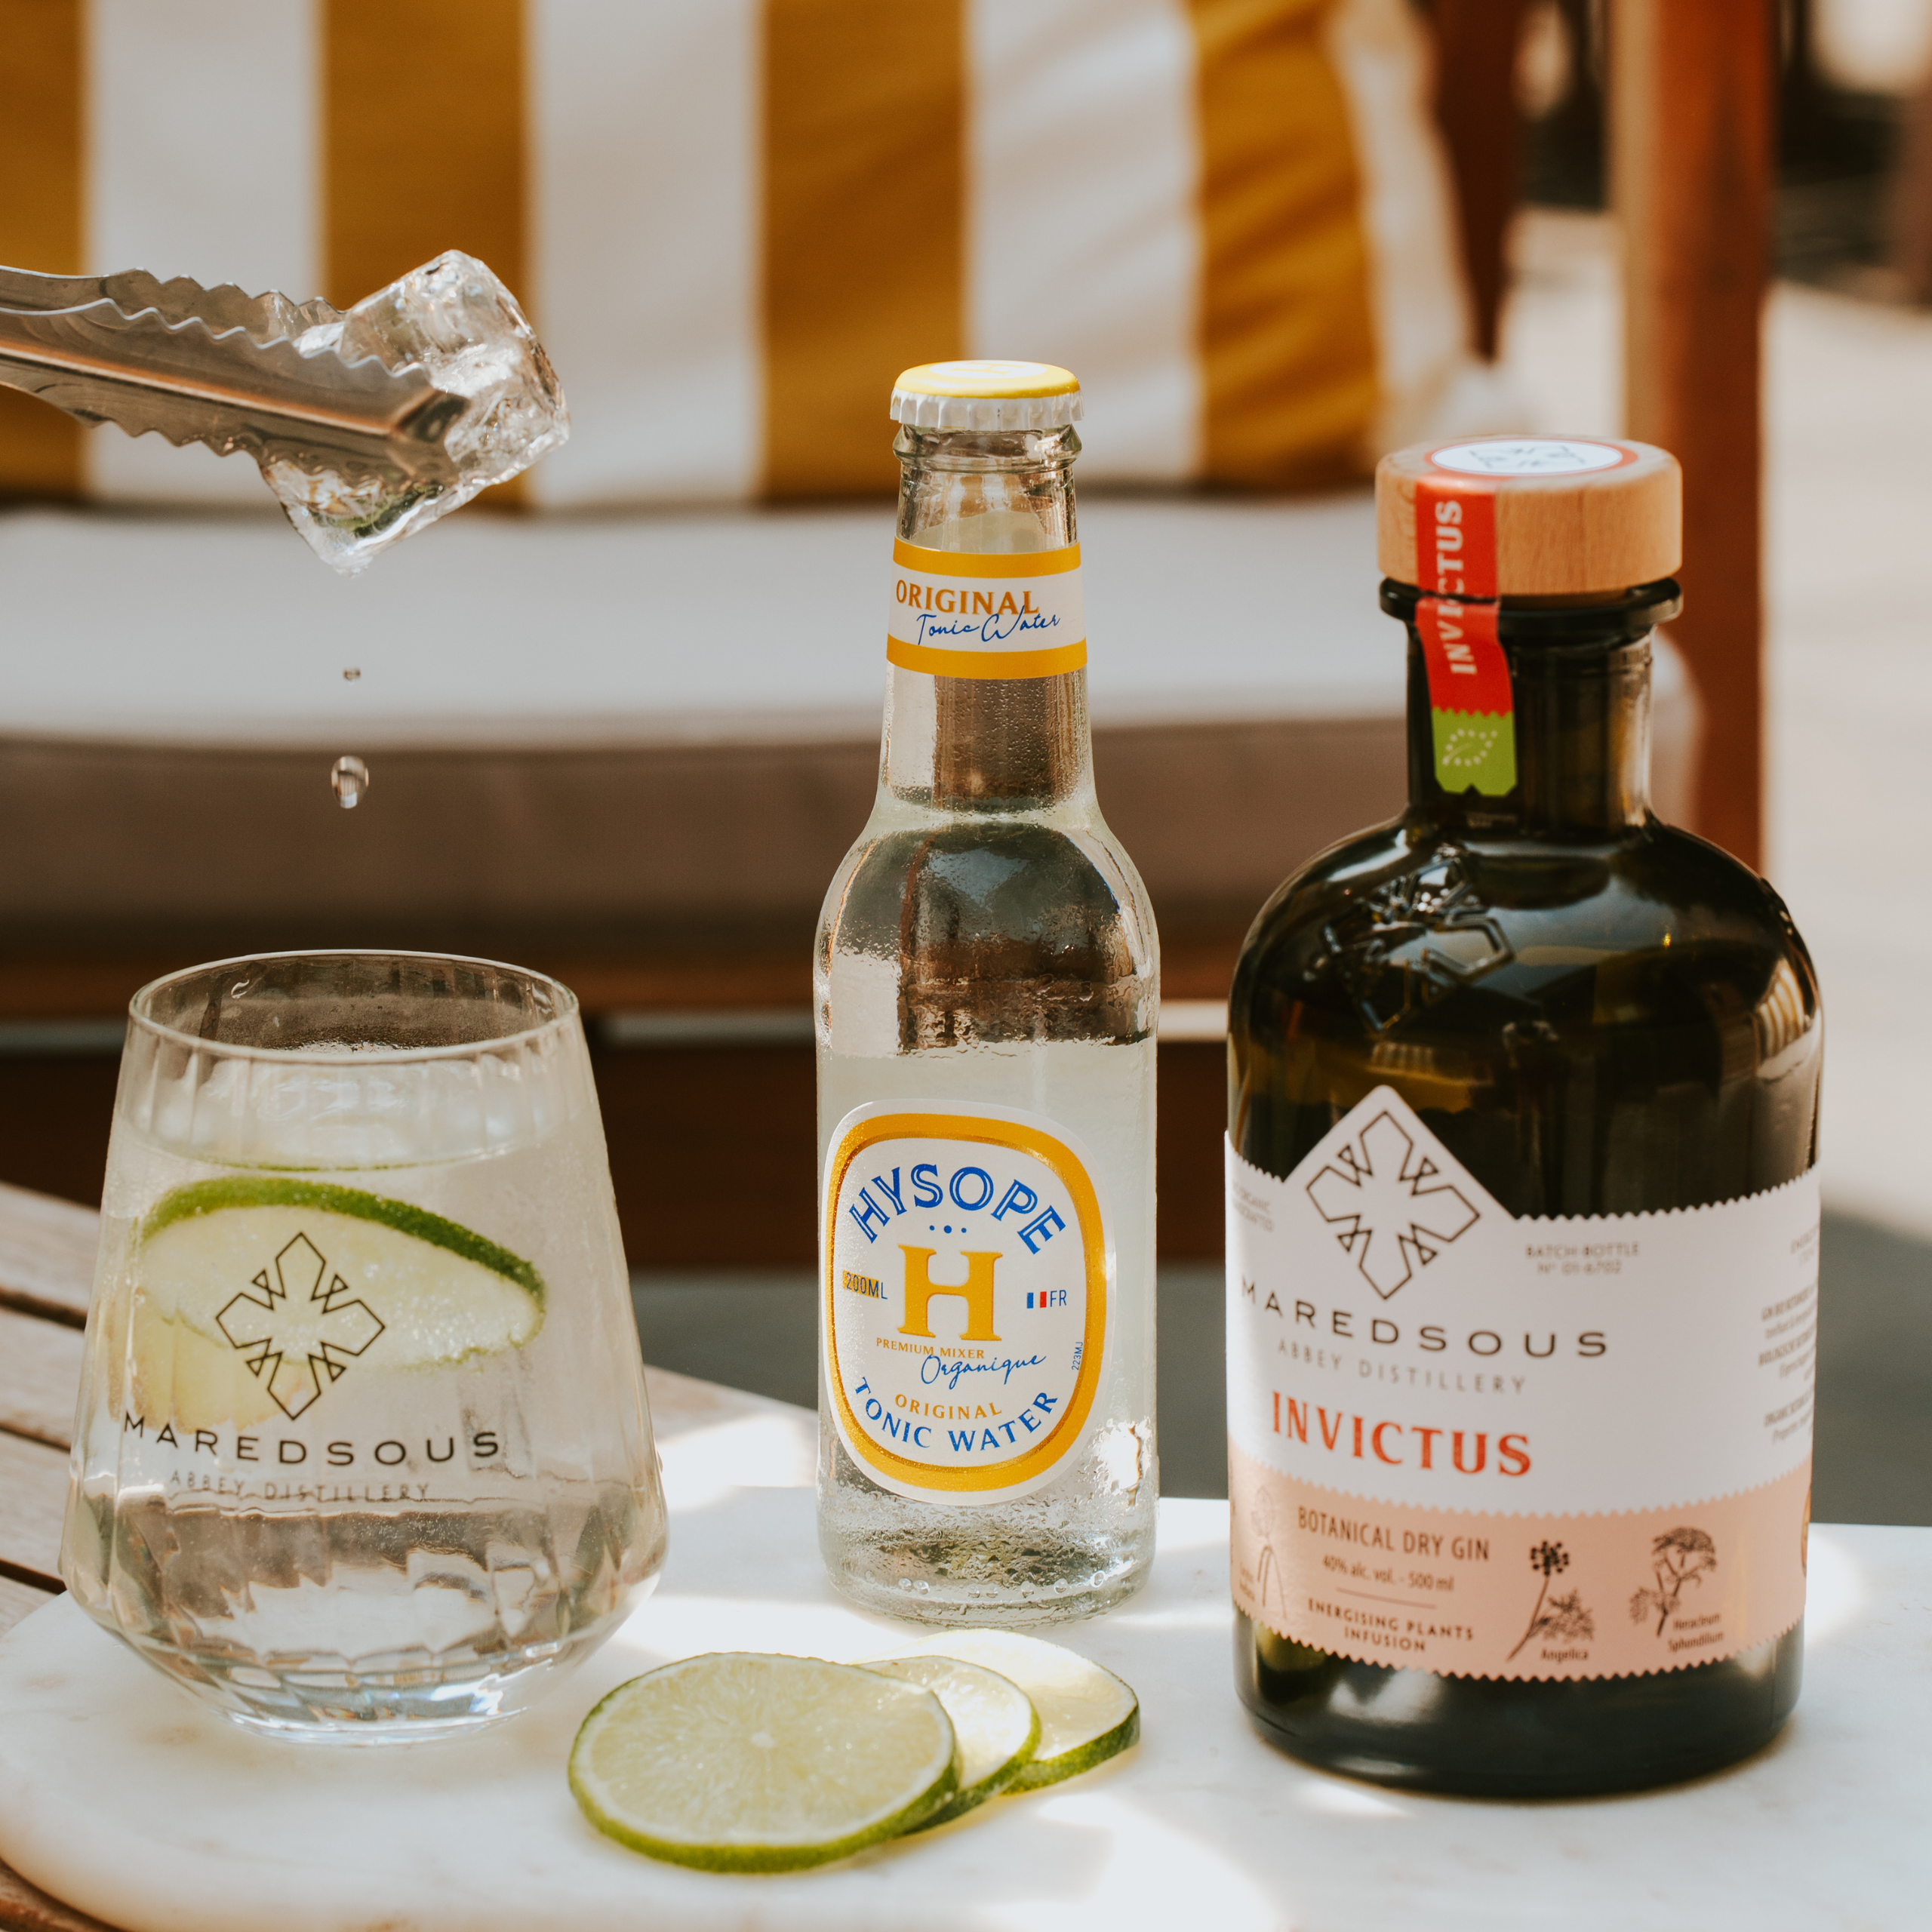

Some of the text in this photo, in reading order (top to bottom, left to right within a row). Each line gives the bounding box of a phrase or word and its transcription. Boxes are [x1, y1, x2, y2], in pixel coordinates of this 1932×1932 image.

[896, 579, 1040, 615] ORIGINAL
[1435, 500, 1477, 675] INVICTUS
[916, 605, 1060, 645] Tonic Water
[849, 1163, 1066, 1255] HYSOPE
[1525, 1241, 1639, 1260] BATCH BOTTLE
[844, 1272, 888, 1300] 200ML
[897, 1244, 1003, 1341] H
[1049, 1289, 1068, 1308] FR
[1241, 1276, 1607, 1359] MAREDSOUS
[876, 1337, 985, 1359] PREMIUM MIXER
[1071, 1341, 1084, 1371] 223MJ
[1278, 1338, 1527, 1395] ABBEY DISTILLERY
[921, 1354, 1047, 1390] Organique
[854, 1377, 1059, 1452] TONIC WATER
[895, 1393, 1002, 1420] ORIGINAL
[123, 1411, 500, 1466] MAREDSOUS
[1272, 1391, 1532, 1478] INVICTUS
[170, 1470, 430, 1503] ABBEY DISTILLERY
[1298, 1506, 1491, 1562] BOTANICAL DRY GIN
[1323, 1554, 1348, 1575] 40%
[1407, 1571, 1434, 1590] 500
[1435, 1574, 1456, 1592] ml
[1308, 1598, 1474, 1641] ENERGISING PLANTS
[1344, 1626, 1426, 1652] INFUSION
[1541, 1648, 1589, 1663] Angelica
